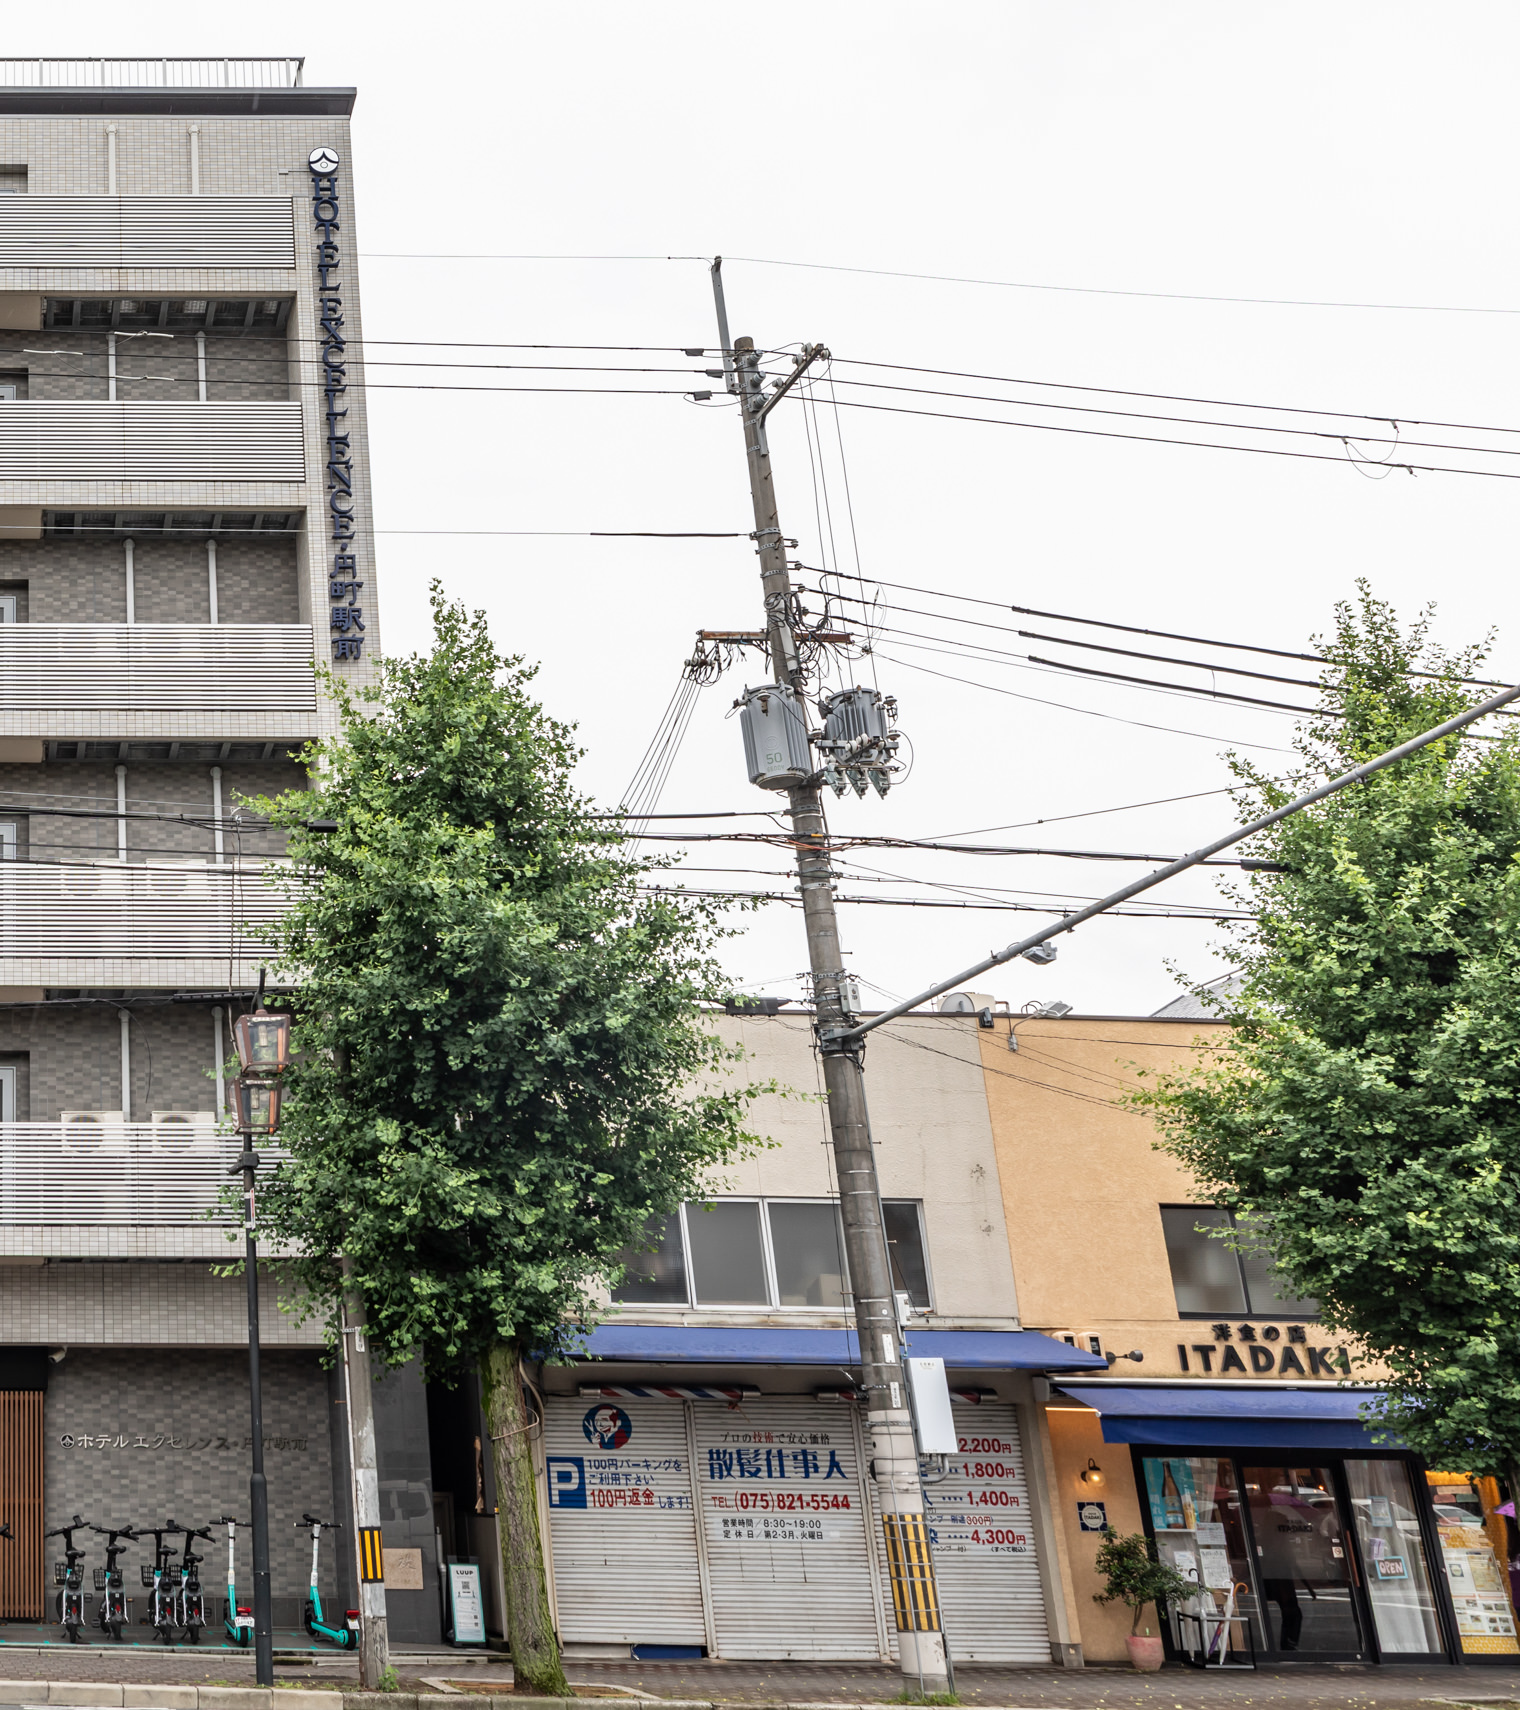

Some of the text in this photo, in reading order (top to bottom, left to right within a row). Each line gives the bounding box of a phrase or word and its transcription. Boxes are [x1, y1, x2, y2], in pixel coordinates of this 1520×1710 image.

[311, 177, 341, 291] HOTEL
[766, 752, 783, 764] 50
[1212, 1322, 1307, 1343] 洋食の店
[1177, 1344, 1352, 1375] ITADAKI
[720, 1431, 830, 1445] プロの技術で安心価格
[958, 1438, 1012, 1454] 2,200円
[587, 1458, 682, 1472] 100円パーキングを
[708, 1449, 849, 1480] 散髪仕事人
[962, 1462, 1016, 1478] 1,800円
[549, 1462, 580, 1505] P
[590, 1487, 655, 1507] 100円返金
[967, 1491, 1020, 1507] 1,400円
[971, 1529, 1027, 1545] 4,300円
[1379, 1561, 1403, 1574] OPEN
